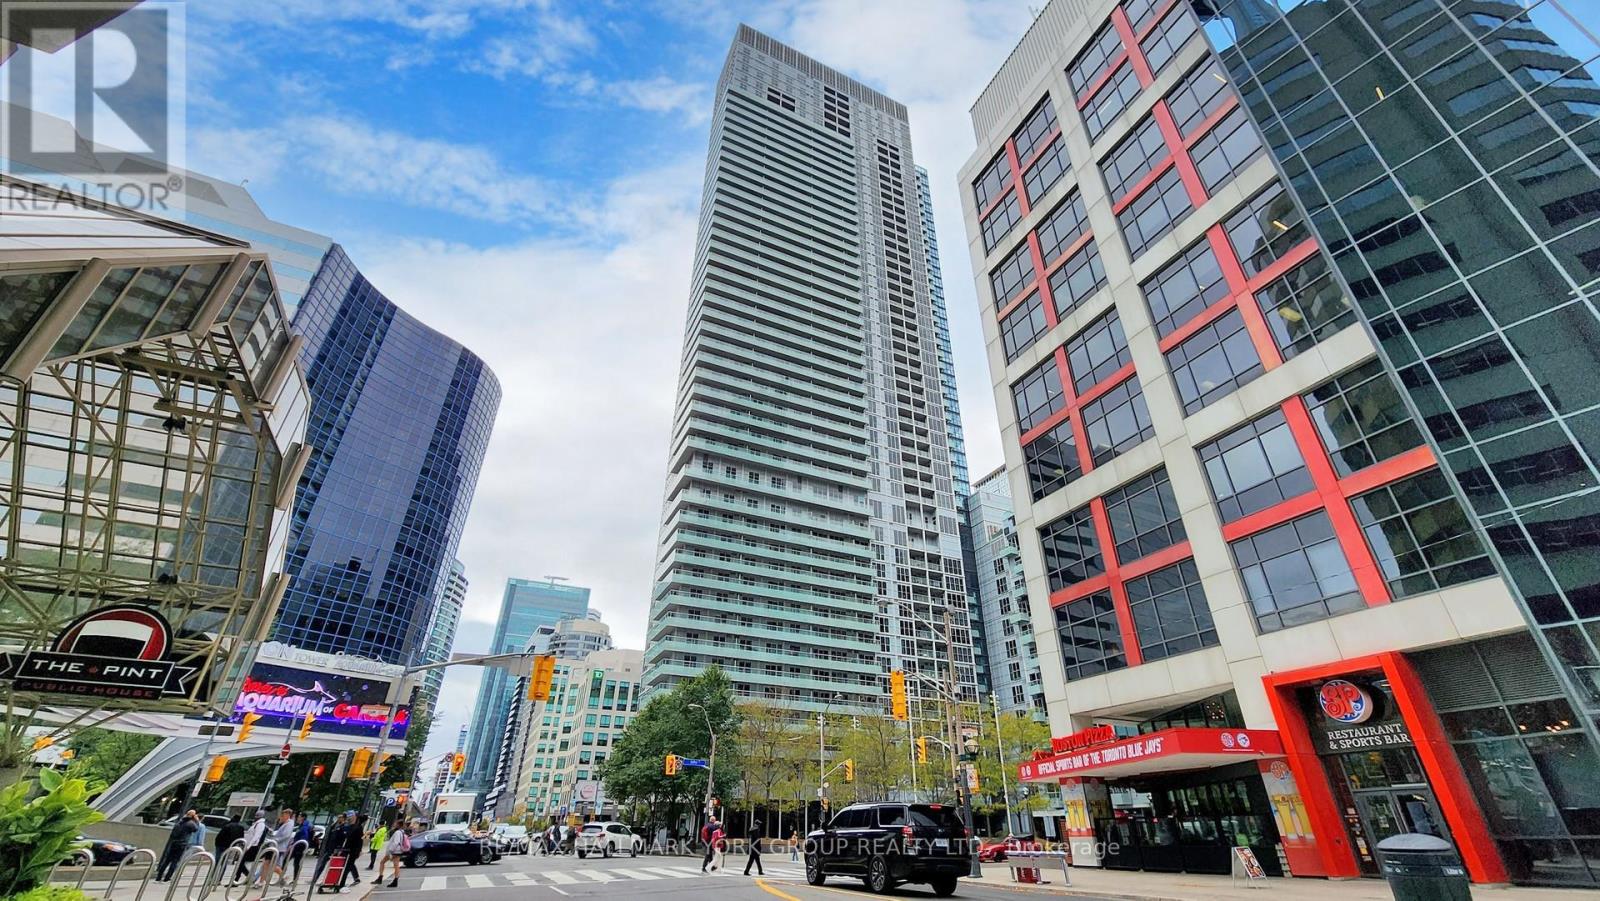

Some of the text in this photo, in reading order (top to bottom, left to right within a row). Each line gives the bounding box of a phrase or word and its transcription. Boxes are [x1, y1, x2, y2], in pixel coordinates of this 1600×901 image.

[32, 659, 163, 679] THE PINT
[20, 681, 155, 697] PUBLIC HOUSE
[1327, 724, 1402, 740] RESTAURANT
[1329, 733, 1410, 750] & SPORTS BAR
[1038, 761, 1056, 775] OFFICIAL
[1055, 757, 1073, 771] SPORTS
[1072, 755, 1084, 769] BAR
[1083, 753, 1090, 767] OF
[1090, 751, 1101, 765] THE
[1101, 745, 1127, 763] TORONTO
[1127, 741, 1143, 758] BLUE
